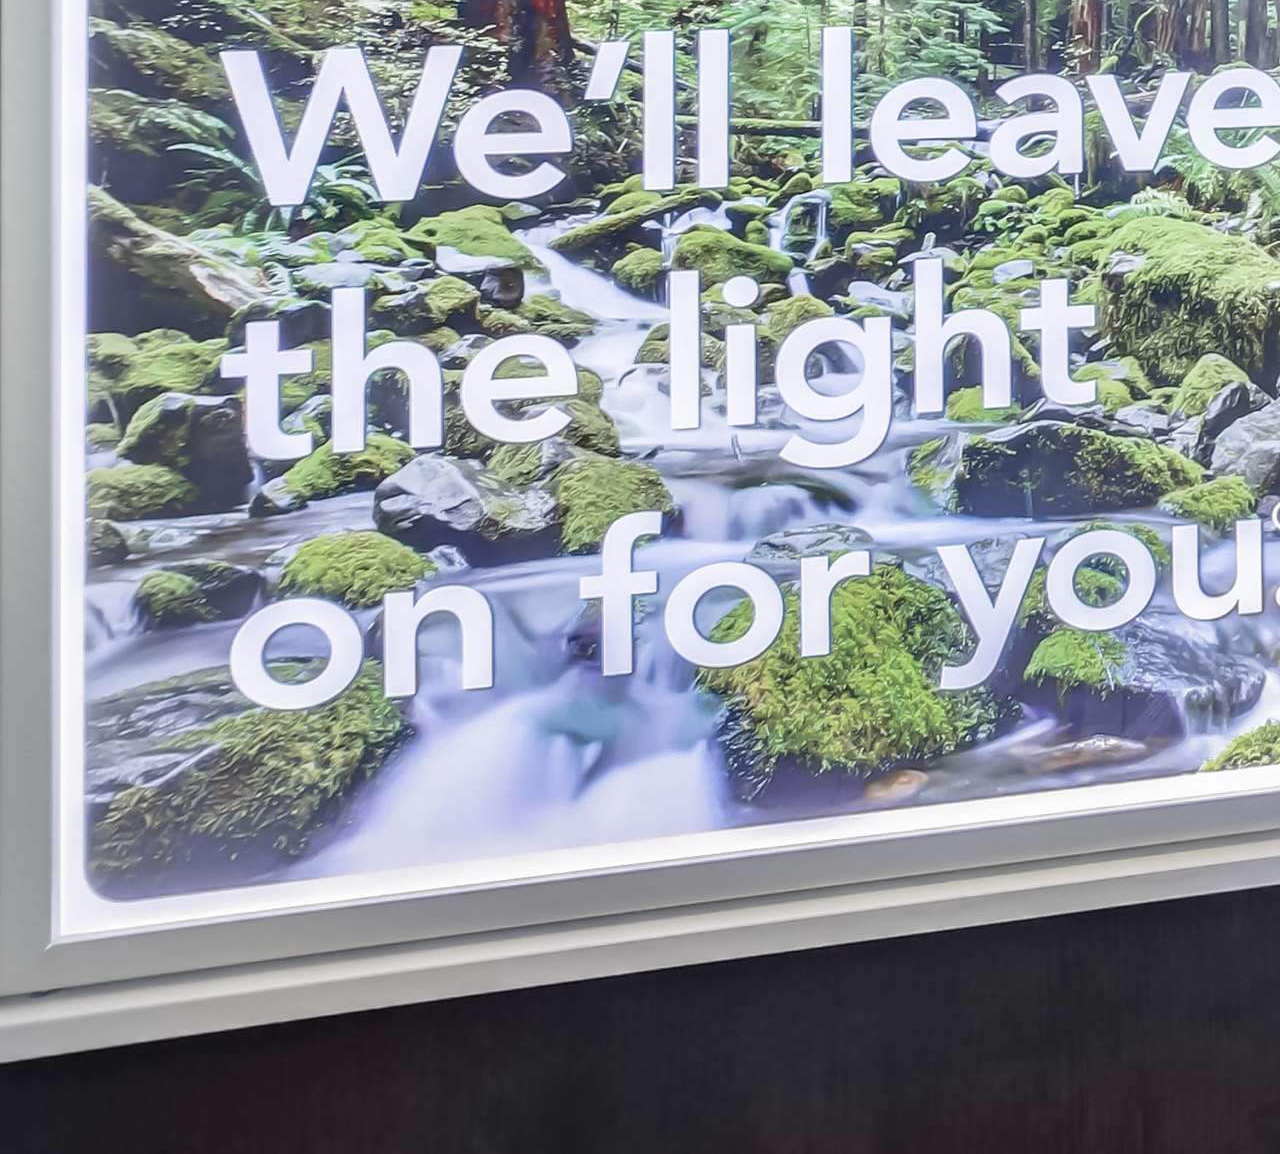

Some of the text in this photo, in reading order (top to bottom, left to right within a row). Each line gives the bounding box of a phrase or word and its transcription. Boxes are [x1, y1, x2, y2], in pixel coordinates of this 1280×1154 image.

[219, 29, 729, 207] We'll
[219, 258, 1098, 470] the light
[229, 584, 494, 712] on
[580, 511, 870, 678] for
